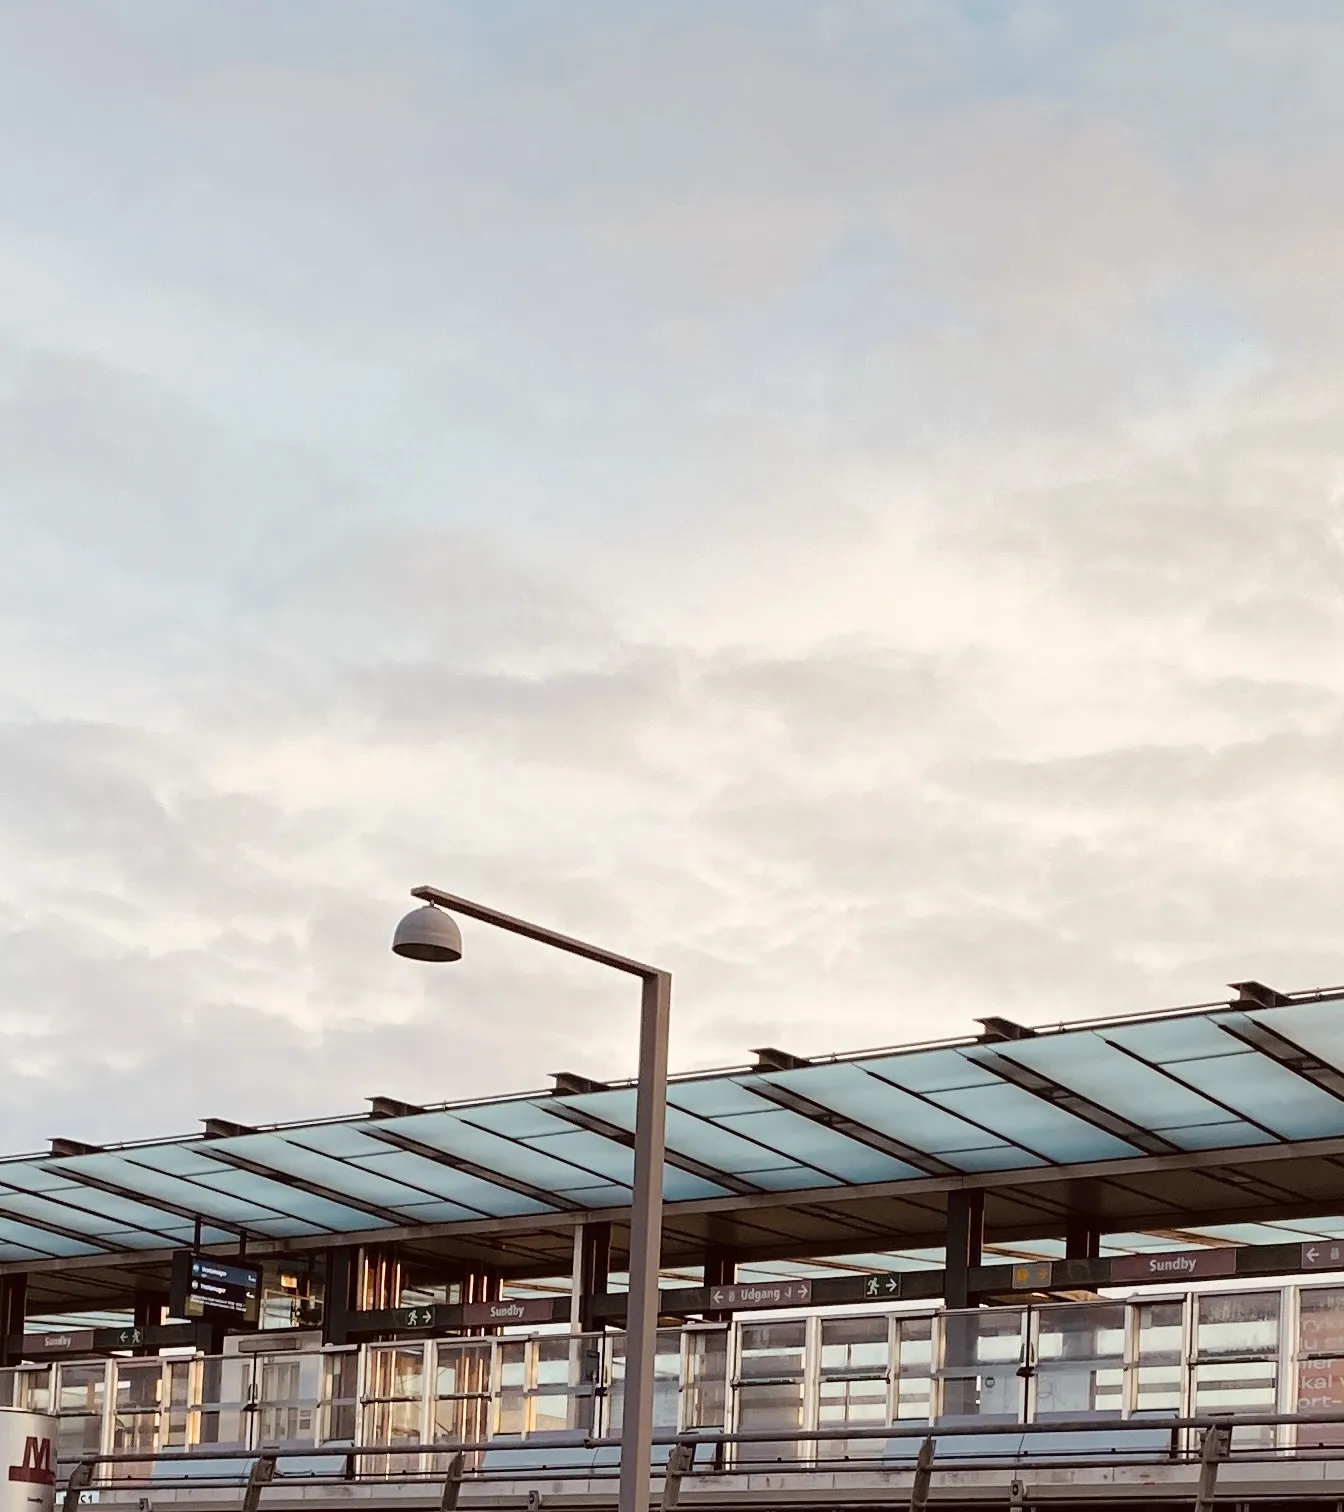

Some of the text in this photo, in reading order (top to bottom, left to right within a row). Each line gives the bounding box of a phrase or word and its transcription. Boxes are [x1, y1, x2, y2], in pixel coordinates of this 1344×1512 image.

[1149, 1256, 1197, 1273] Sundby
[740, 1287, 781, 1303] Udgang
[490, 1304, 525, 1318] Sundby
[1298, 1374, 1333, 1390] kal
